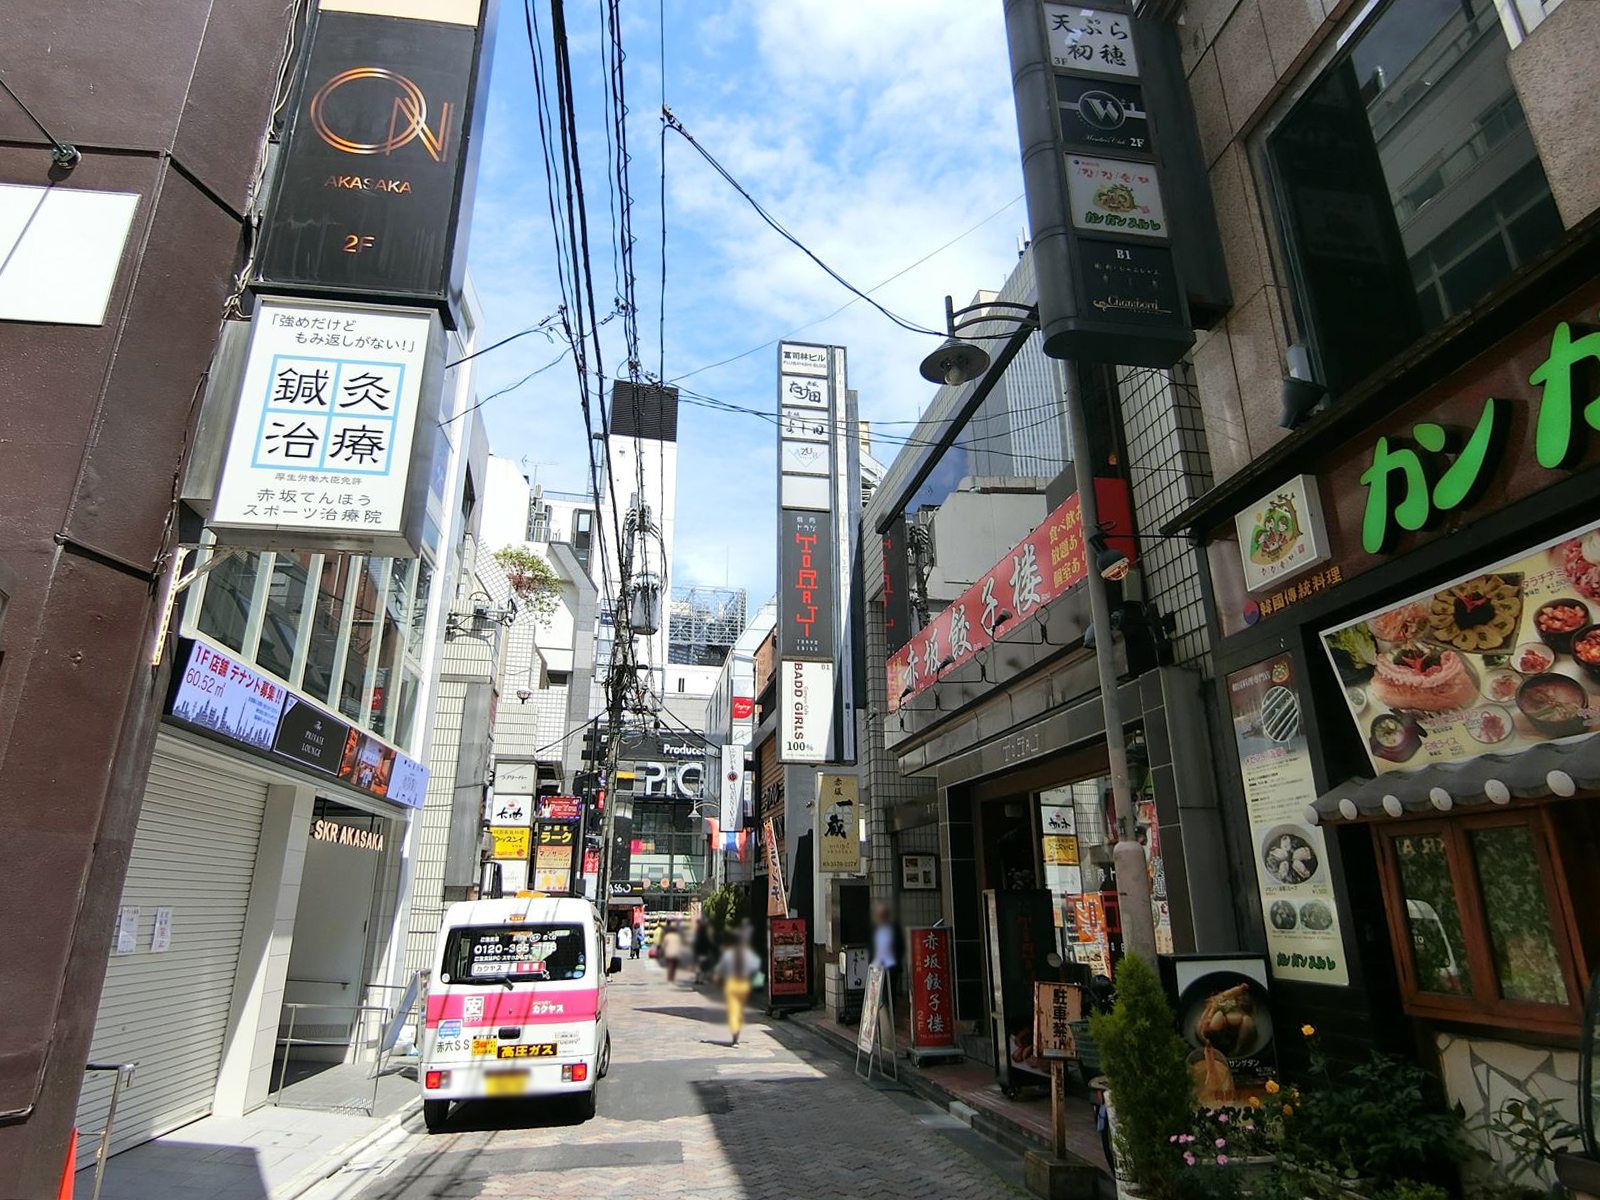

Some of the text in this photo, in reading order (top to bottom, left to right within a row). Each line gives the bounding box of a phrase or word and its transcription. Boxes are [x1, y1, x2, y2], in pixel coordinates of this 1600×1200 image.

[1054, 57, 1067, 65] 3F
[1067, 39, 1126, 67] 初穂
[1129, 138, 1145, 147] 2F
[323, 174, 413, 194] AKASAKA
[343, 234, 376, 253] 2F
[1116, 249, 1132, 260] B1
[271, 313, 357, 332] 「強めだけど
[273, 368, 391, 412] 鍼灸
[265, 421, 386, 465] 治療
[274, 472, 363, 486] 厚生労働大臣免許
[243, 504, 383, 525] スポーツ治療院
[195, 645, 211, 666] 1F
[186, 668, 215, 694] 60.52
[794, 663, 805, 740] BADD GIRLS
[787, 741, 814, 752] 100%
[314, 819, 384, 851] SKR AKASAKA
[922, 931, 944, 1033] 赤坂餃子楼
[532, 1004, 564, 1014] カクヤス
[917, 1010, 925, 1030] 2F
[501, 1045, 554, 1058] 高圧ガス
